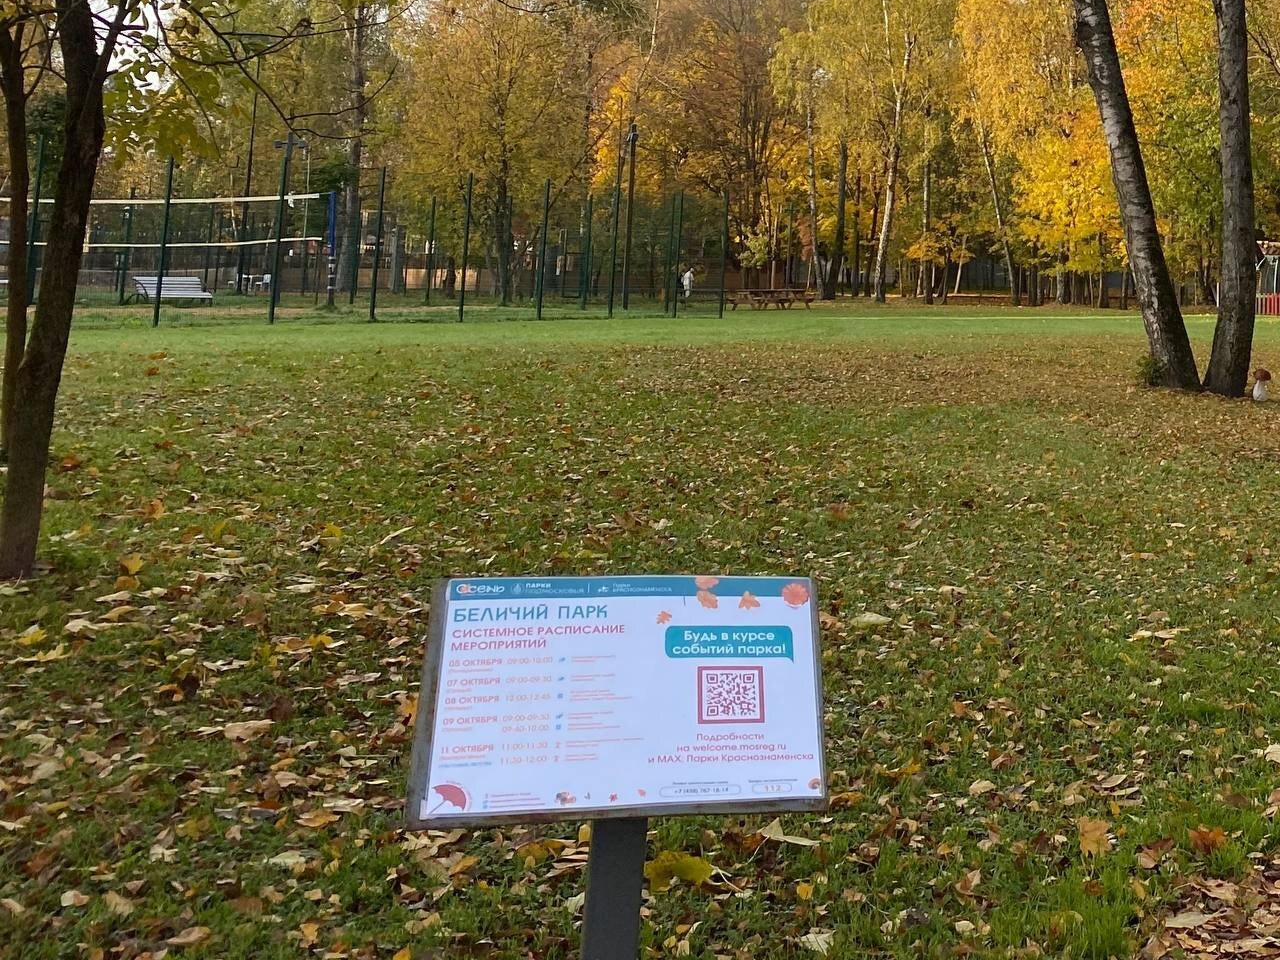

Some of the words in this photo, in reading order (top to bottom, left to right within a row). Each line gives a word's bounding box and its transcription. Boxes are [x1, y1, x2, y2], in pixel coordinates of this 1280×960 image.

[454, 604, 548, 622] БЕЛИЧИЙ
[558, 605, 608, 619] ПАРК
[452, 626, 533, 639] СИСТЕМНОЕ
[537, 624, 625, 636] РАСПИСАНИЕ
[684, 630, 717, 642] Будь
[732, 632, 775, 643] курсе
[451, 638, 547, 651] МЕРОПРИЯТИЙ
[672, 644, 734, 655] событий
[738, 643, 786, 656] парка!
[696, 732, 765, 742] Подробности
[676, 745, 690, 753] на
[693, 743, 787, 753] welcome.mosreg.ru
[686, 755, 719, 764] Парки
[721, 753, 814, 762] Краснознаменска
